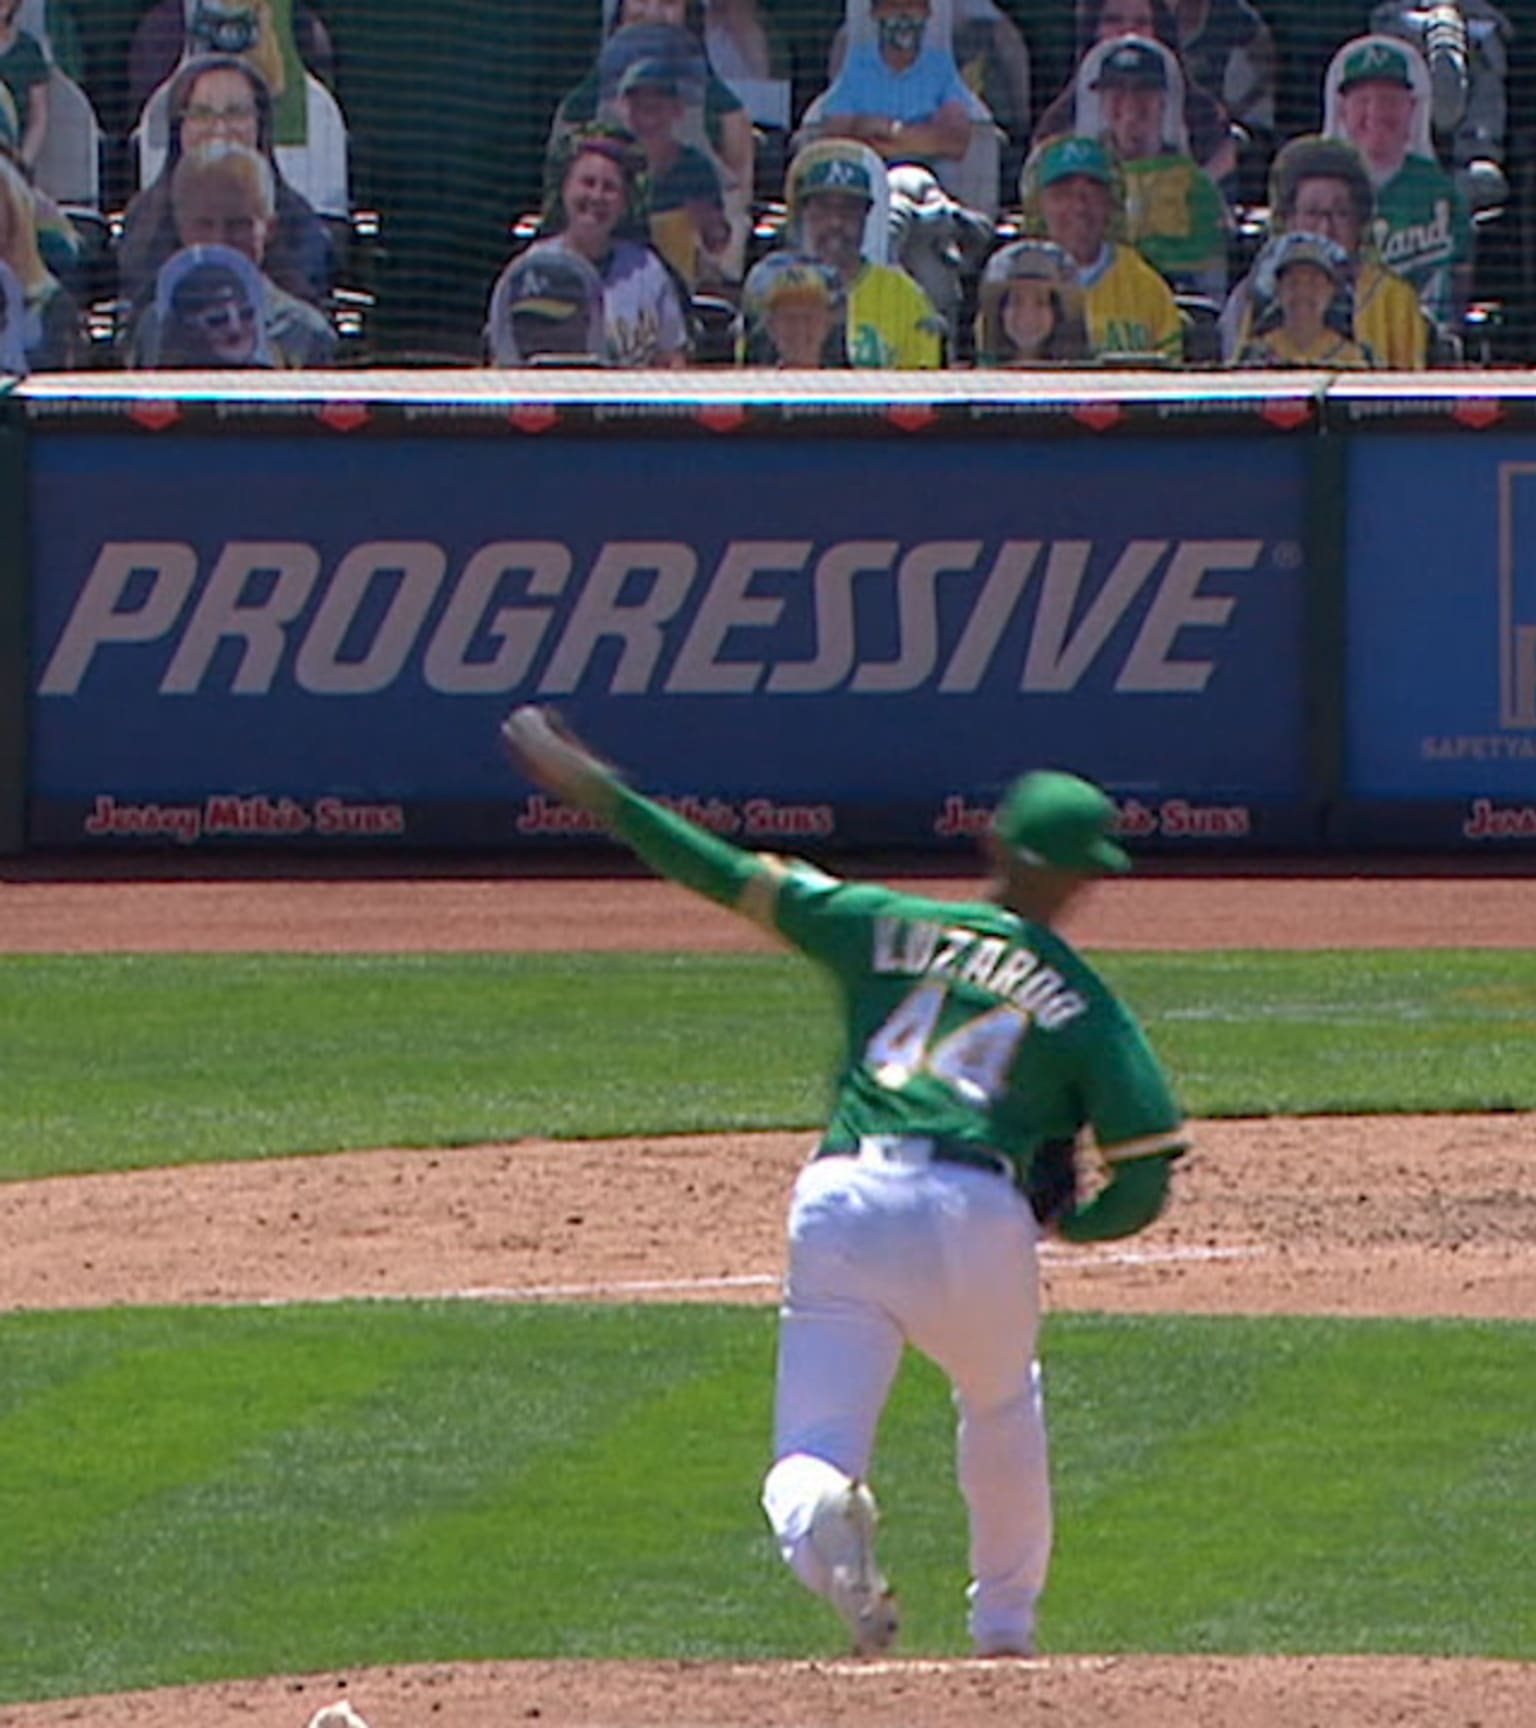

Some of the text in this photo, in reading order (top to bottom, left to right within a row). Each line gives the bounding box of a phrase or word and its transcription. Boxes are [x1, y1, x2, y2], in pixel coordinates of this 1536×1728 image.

[37, 540, 1263, 695] PROGRESSIVE
[872, 915, 1088, 1031] LUZARDO
[862, 978, 1032, 1106] 44
